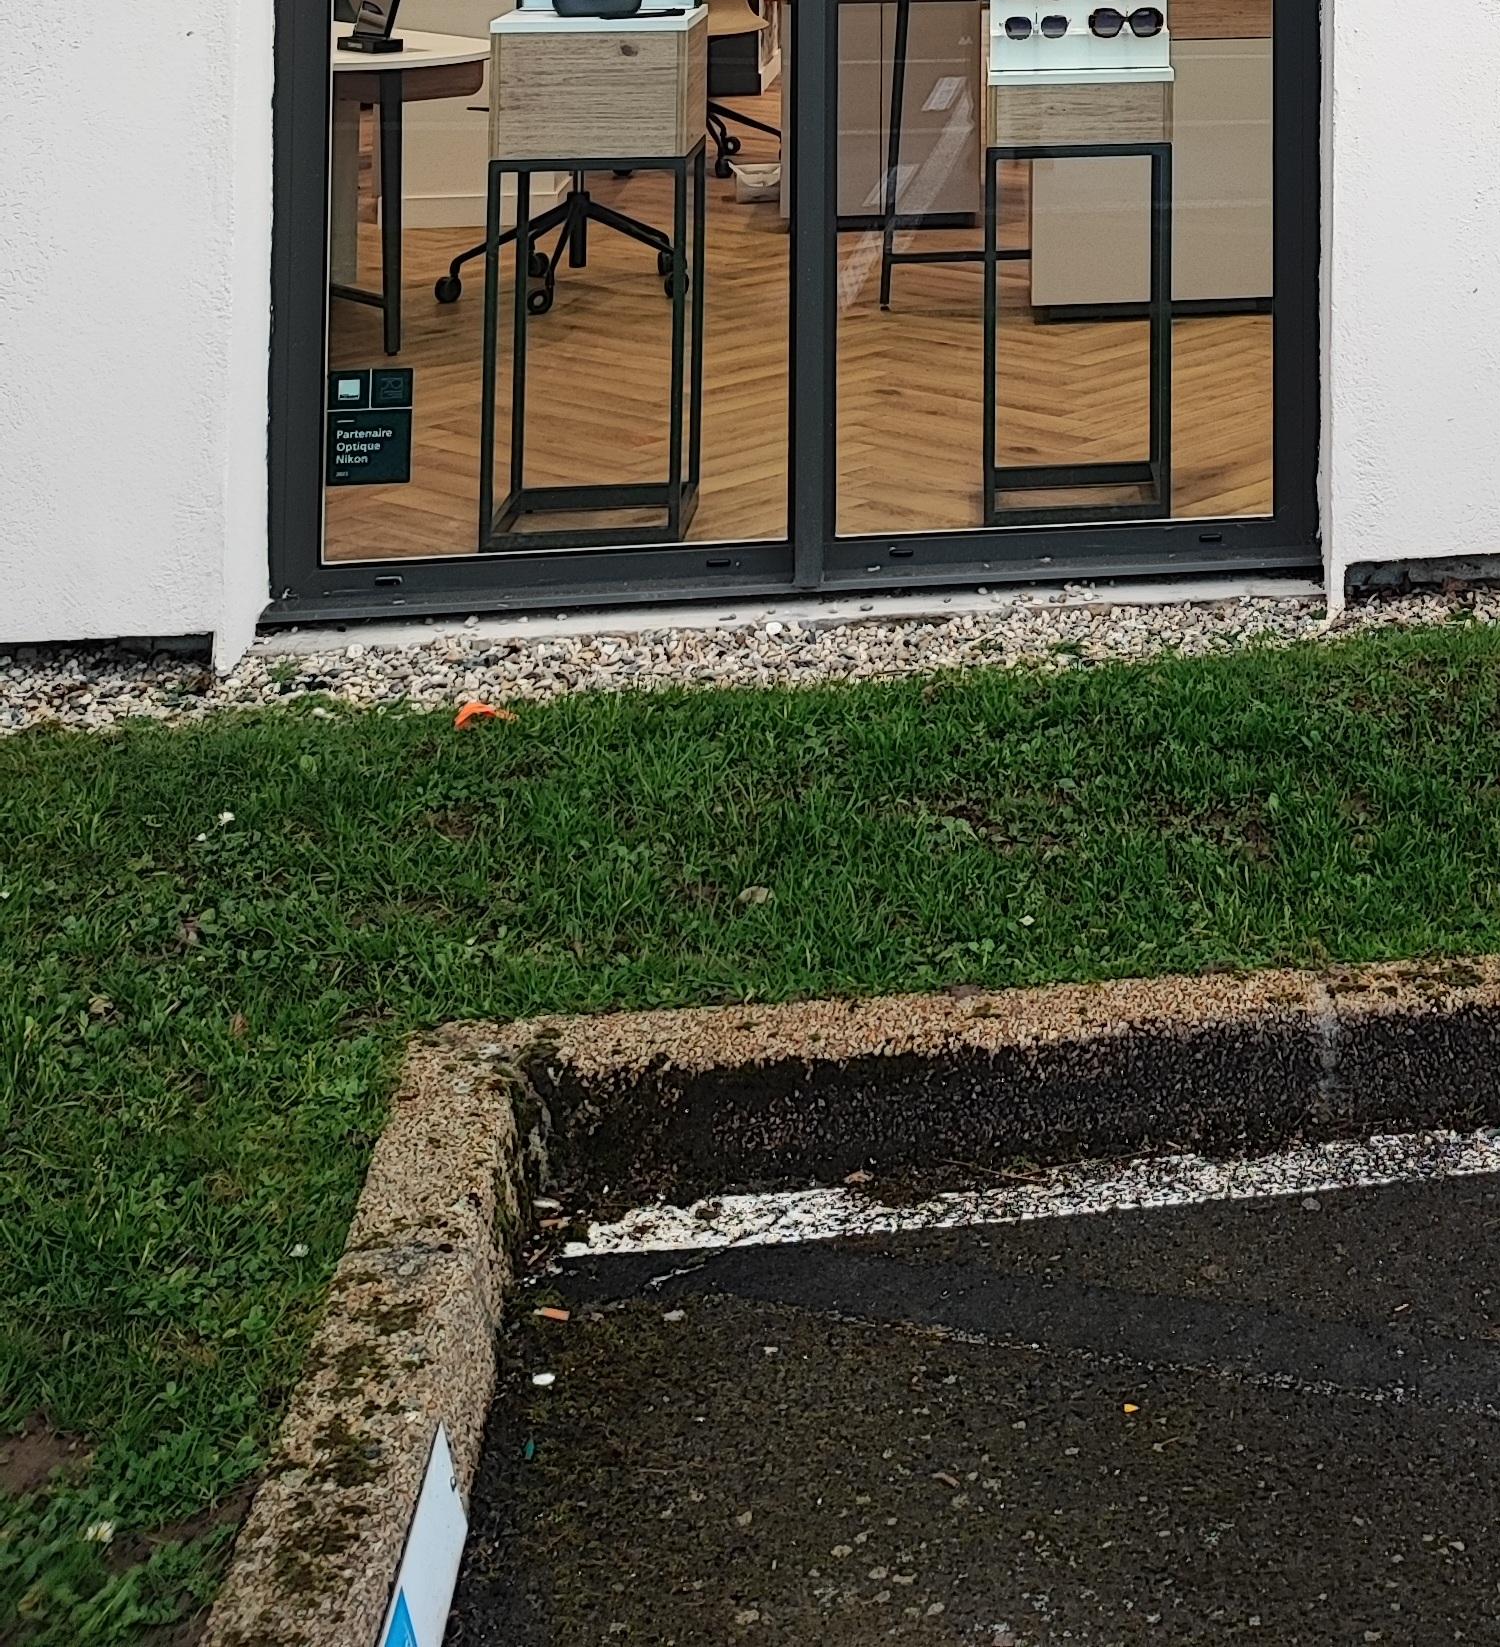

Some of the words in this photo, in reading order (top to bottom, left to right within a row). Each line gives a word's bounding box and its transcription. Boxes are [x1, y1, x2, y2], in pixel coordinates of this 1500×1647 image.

[336, 428, 393, 440] Partenaire
[336, 441, 381, 454] Optique
[335, 454, 369, 465] Nikon
